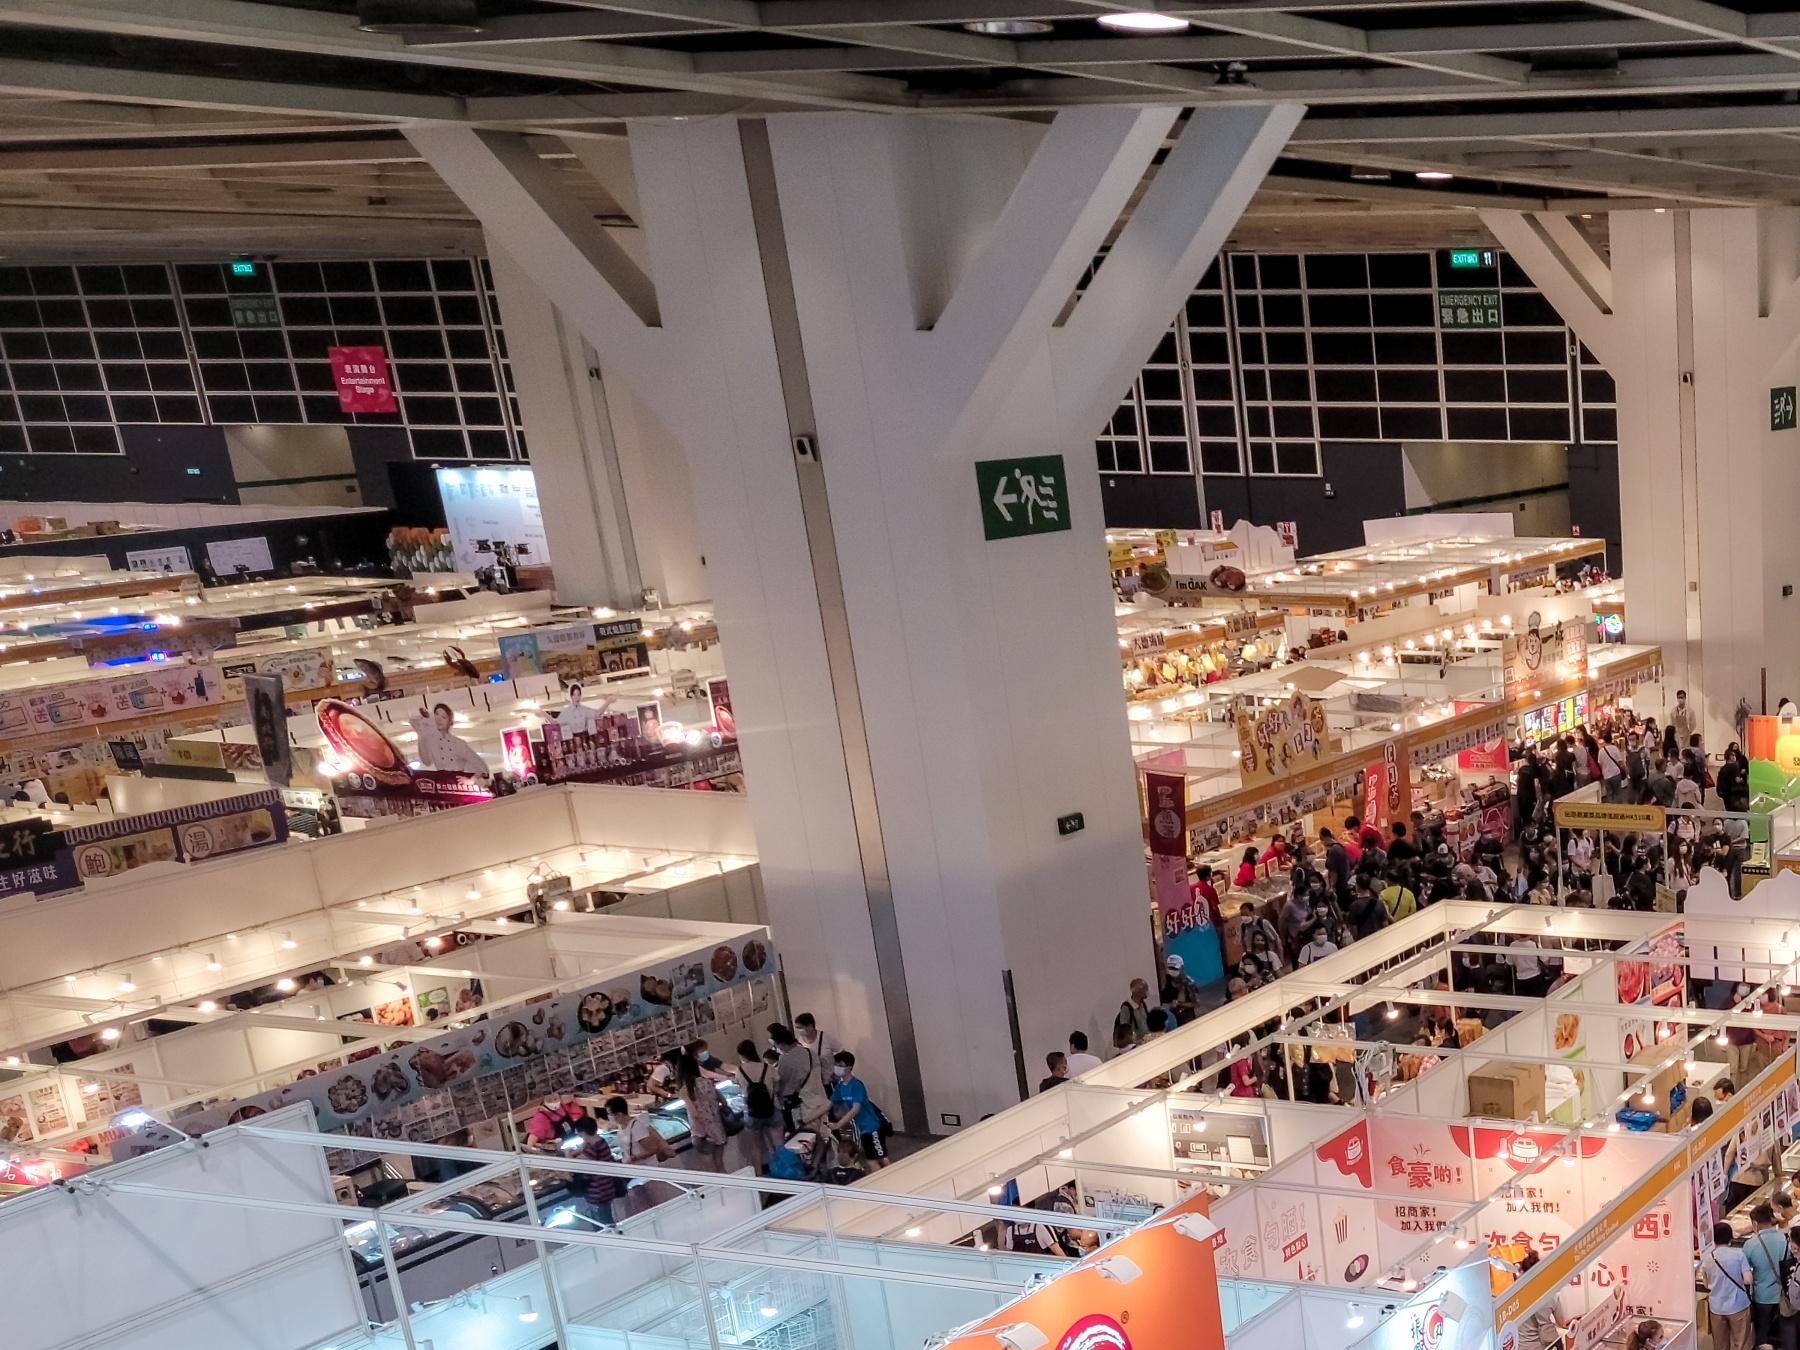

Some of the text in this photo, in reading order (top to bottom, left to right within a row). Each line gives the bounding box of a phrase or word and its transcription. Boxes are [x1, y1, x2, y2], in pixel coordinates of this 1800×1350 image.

[1440, 294, 1498, 306] EMERGENCY EXIT
[1441, 307, 1499, 324] 緊急出口
[340, 376, 386, 386] Entertainment
[355, 385, 375, 396] Stage
[187, 831, 209, 853] 湯
